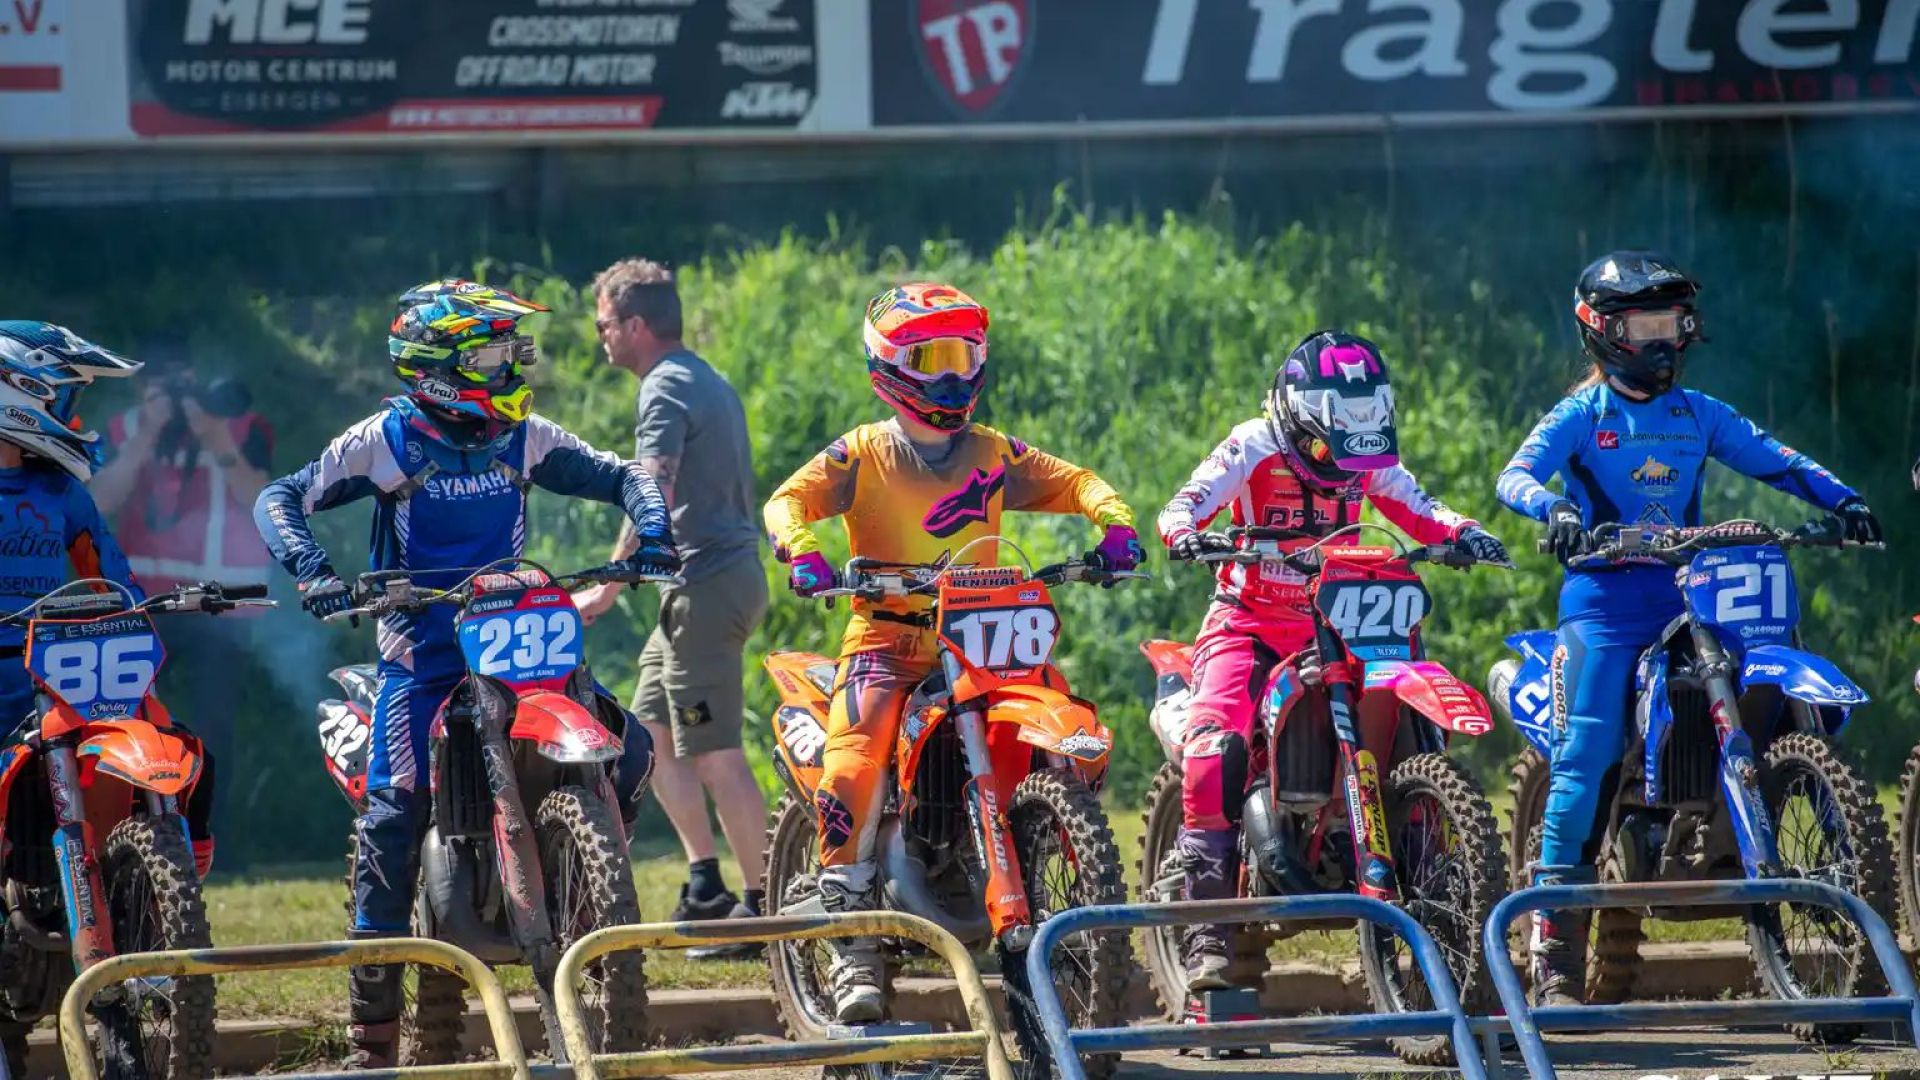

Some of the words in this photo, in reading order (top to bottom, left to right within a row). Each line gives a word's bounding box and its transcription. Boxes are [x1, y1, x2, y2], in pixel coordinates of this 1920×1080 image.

[183, 0, 371, 44] MCE
[488, 15, 681, 46] CROSSMOTOREN
[166, 60, 260, 82] MOTOR
[267, 59, 397, 81] CENTRUM
[455, 56, 567, 86] OFFROAD
[570, 54, 656, 84] MOTOR
[420, 381, 457, 399] Arai
[8, 408, 37, 426] SHOEI
[1350, 436, 1385, 450] Arai
[953, 577, 1016, 588] RENTHAL
[1716, 563, 1787, 624] 21
[482, 599, 515, 611] YAMAHA
[1328, 584, 1425, 639] 420
[81, 618, 147, 634] ESSENTIAL
[949, 608, 1056, 669] 178
[479, 610, 577, 676] 232
[44, 635, 155, 704] 86
[318, 704, 369, 771] 232
